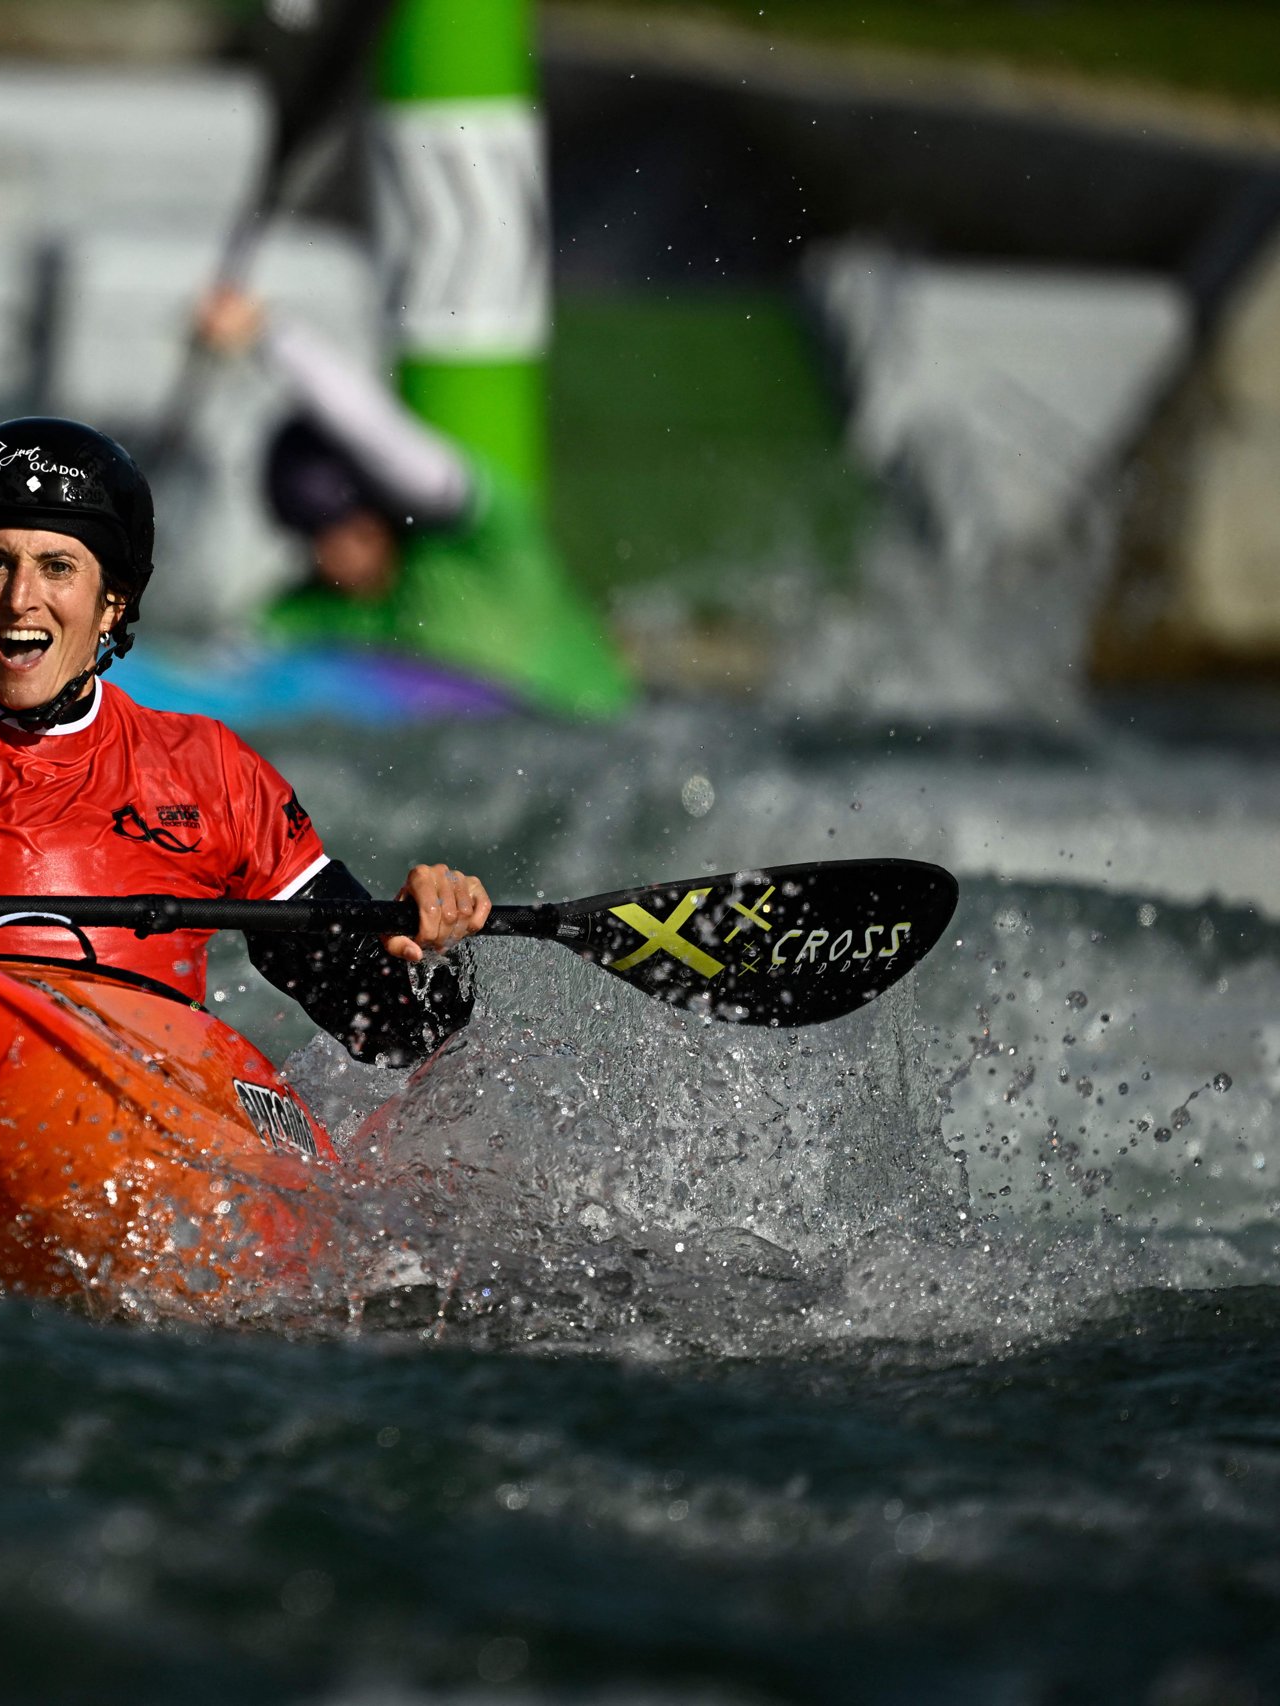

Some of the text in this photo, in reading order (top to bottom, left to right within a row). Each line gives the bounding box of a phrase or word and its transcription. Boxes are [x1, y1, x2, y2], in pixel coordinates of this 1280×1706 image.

[158, 811, 200, 821] canoe
[160, 820, 201, 829] federation
[771, 921, 912, 964] CROSS
[766, 957, 899, 976] PADDLE
